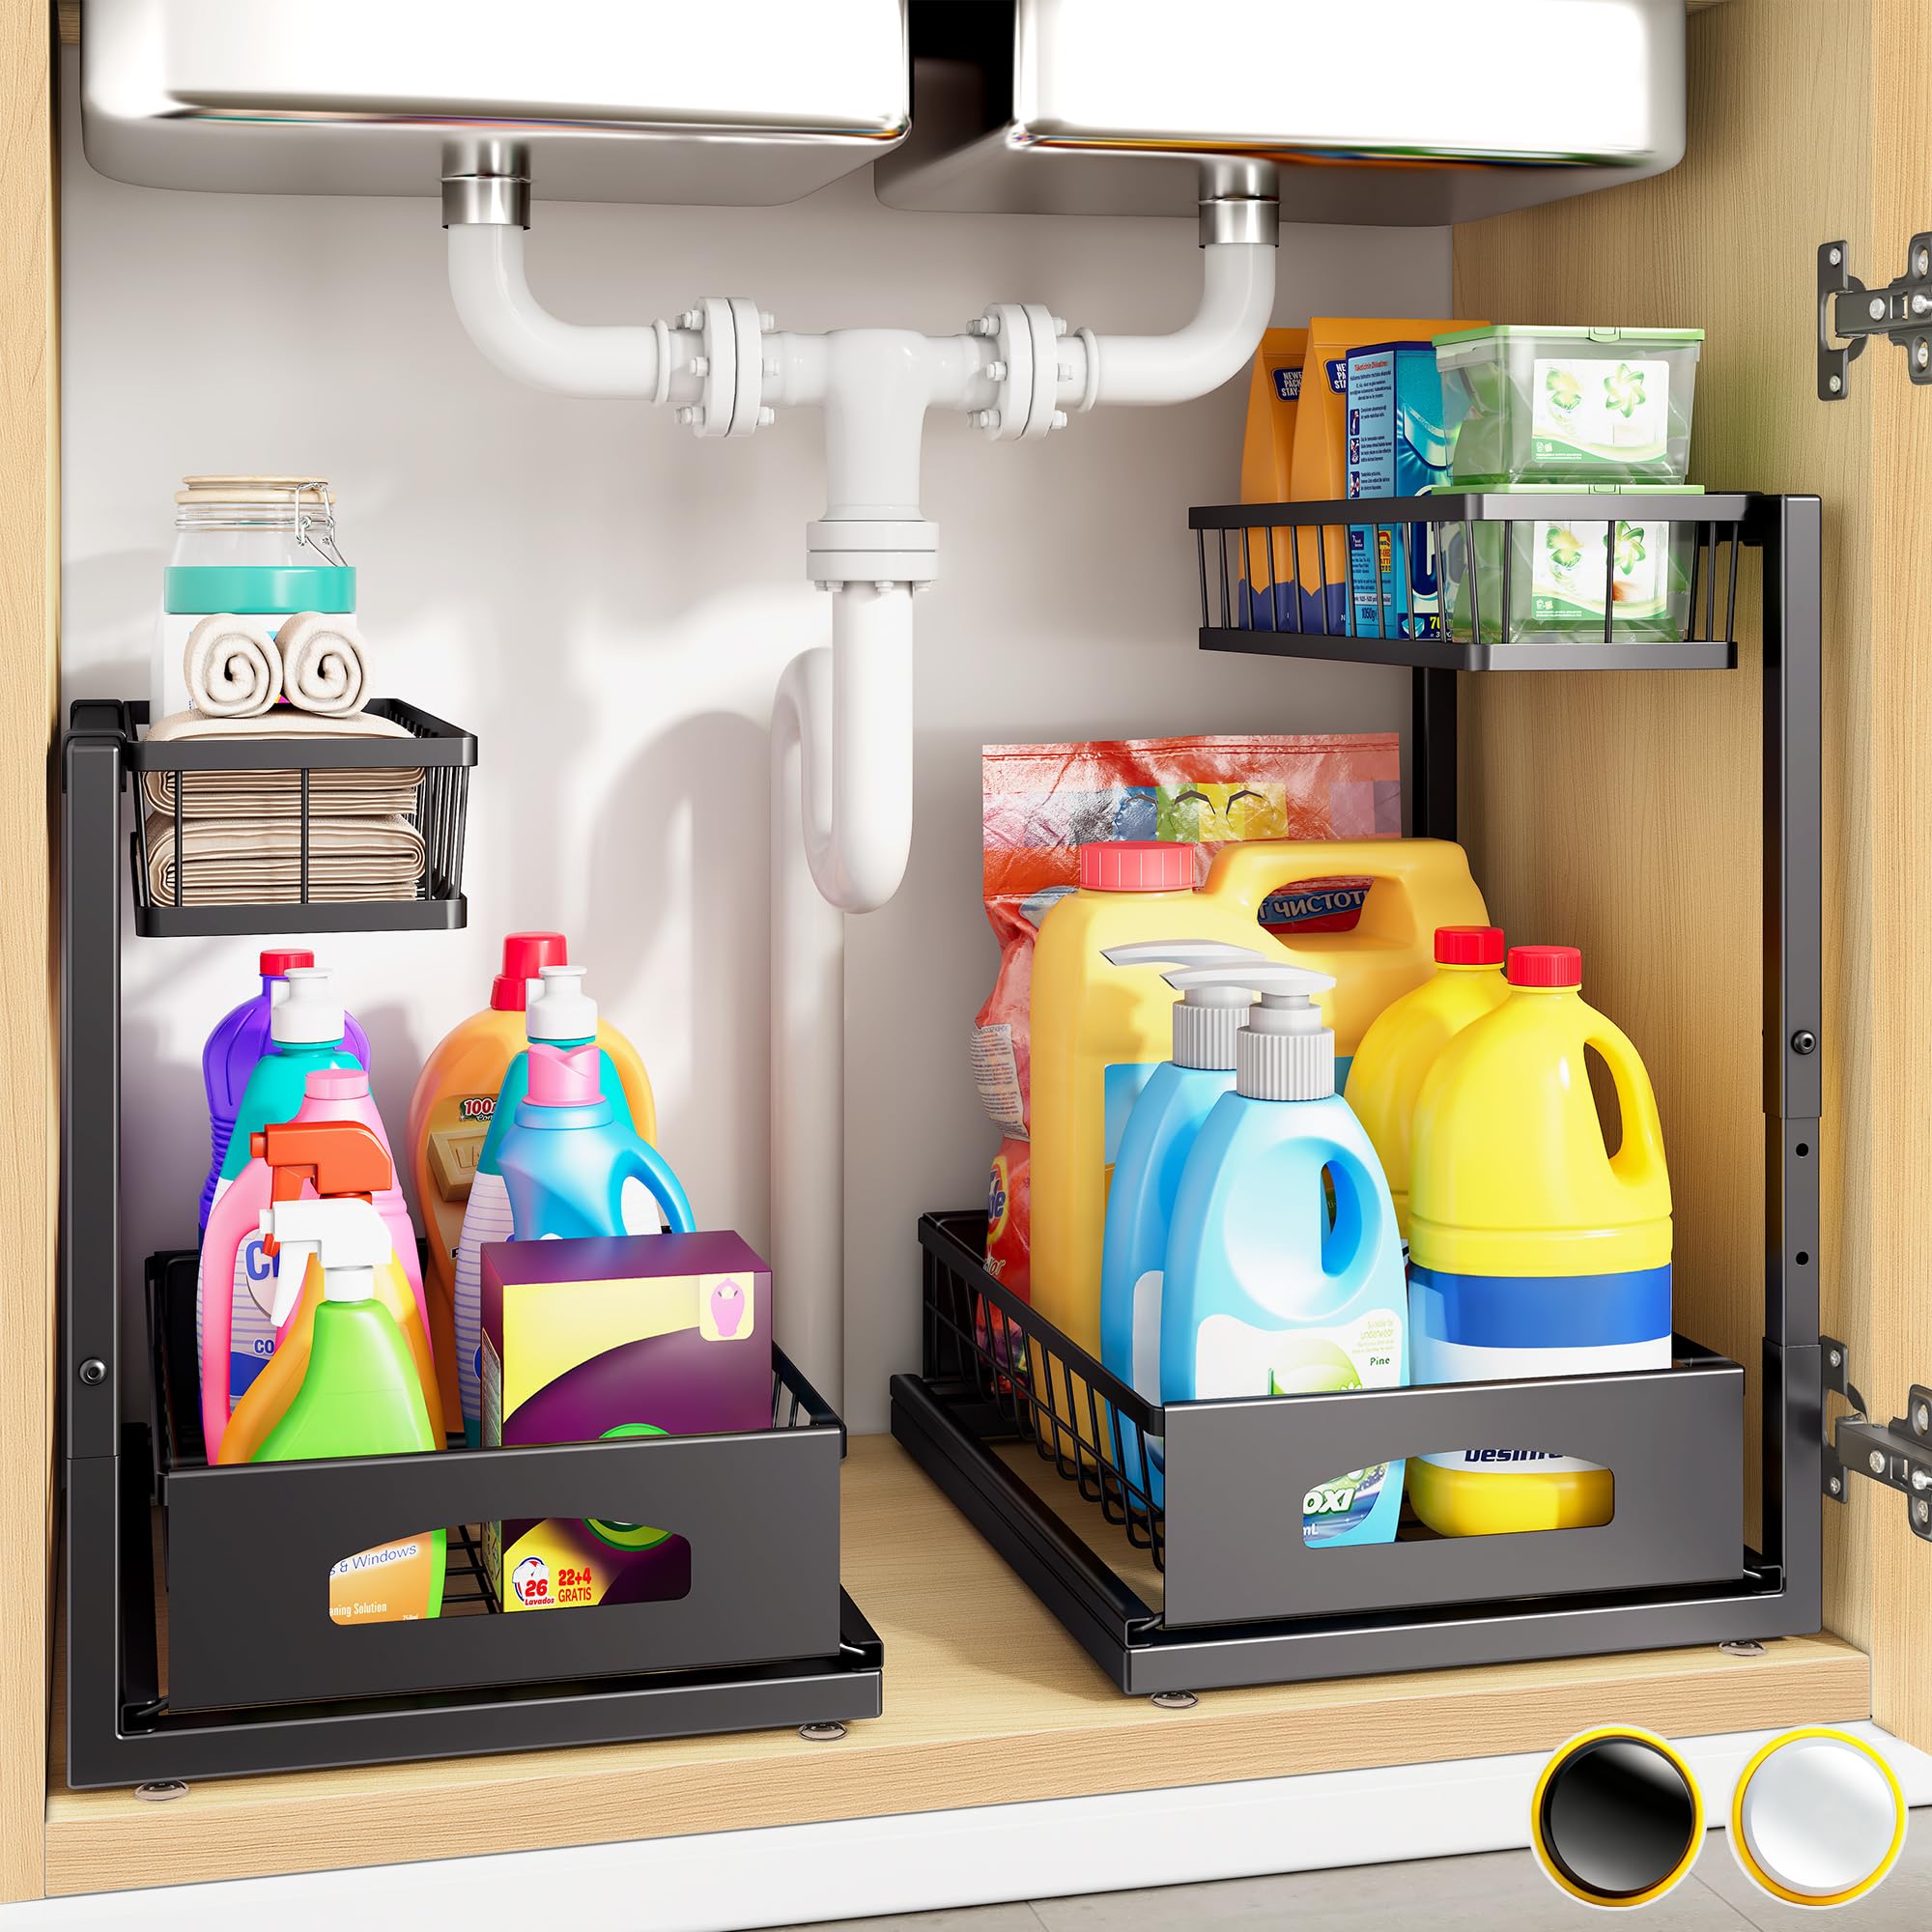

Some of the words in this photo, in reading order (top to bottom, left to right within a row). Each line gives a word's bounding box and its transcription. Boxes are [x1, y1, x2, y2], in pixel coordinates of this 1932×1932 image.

[1370, 1356, 1390, 1367] Pine
[1302, 1488, 1355, 1515] OXI
[340, 1560, 348, 1573] &
[353, 1544, 417, 1570] Windows
[558, 1567, 592, 1586] 22+4
[525, 1578, 549, 1597] 26
[557, 1587, 592, 1603] GRATIS
[354, 1602, 387, 1615] Solution
[525, 1597, 554, 1605] Lavados
